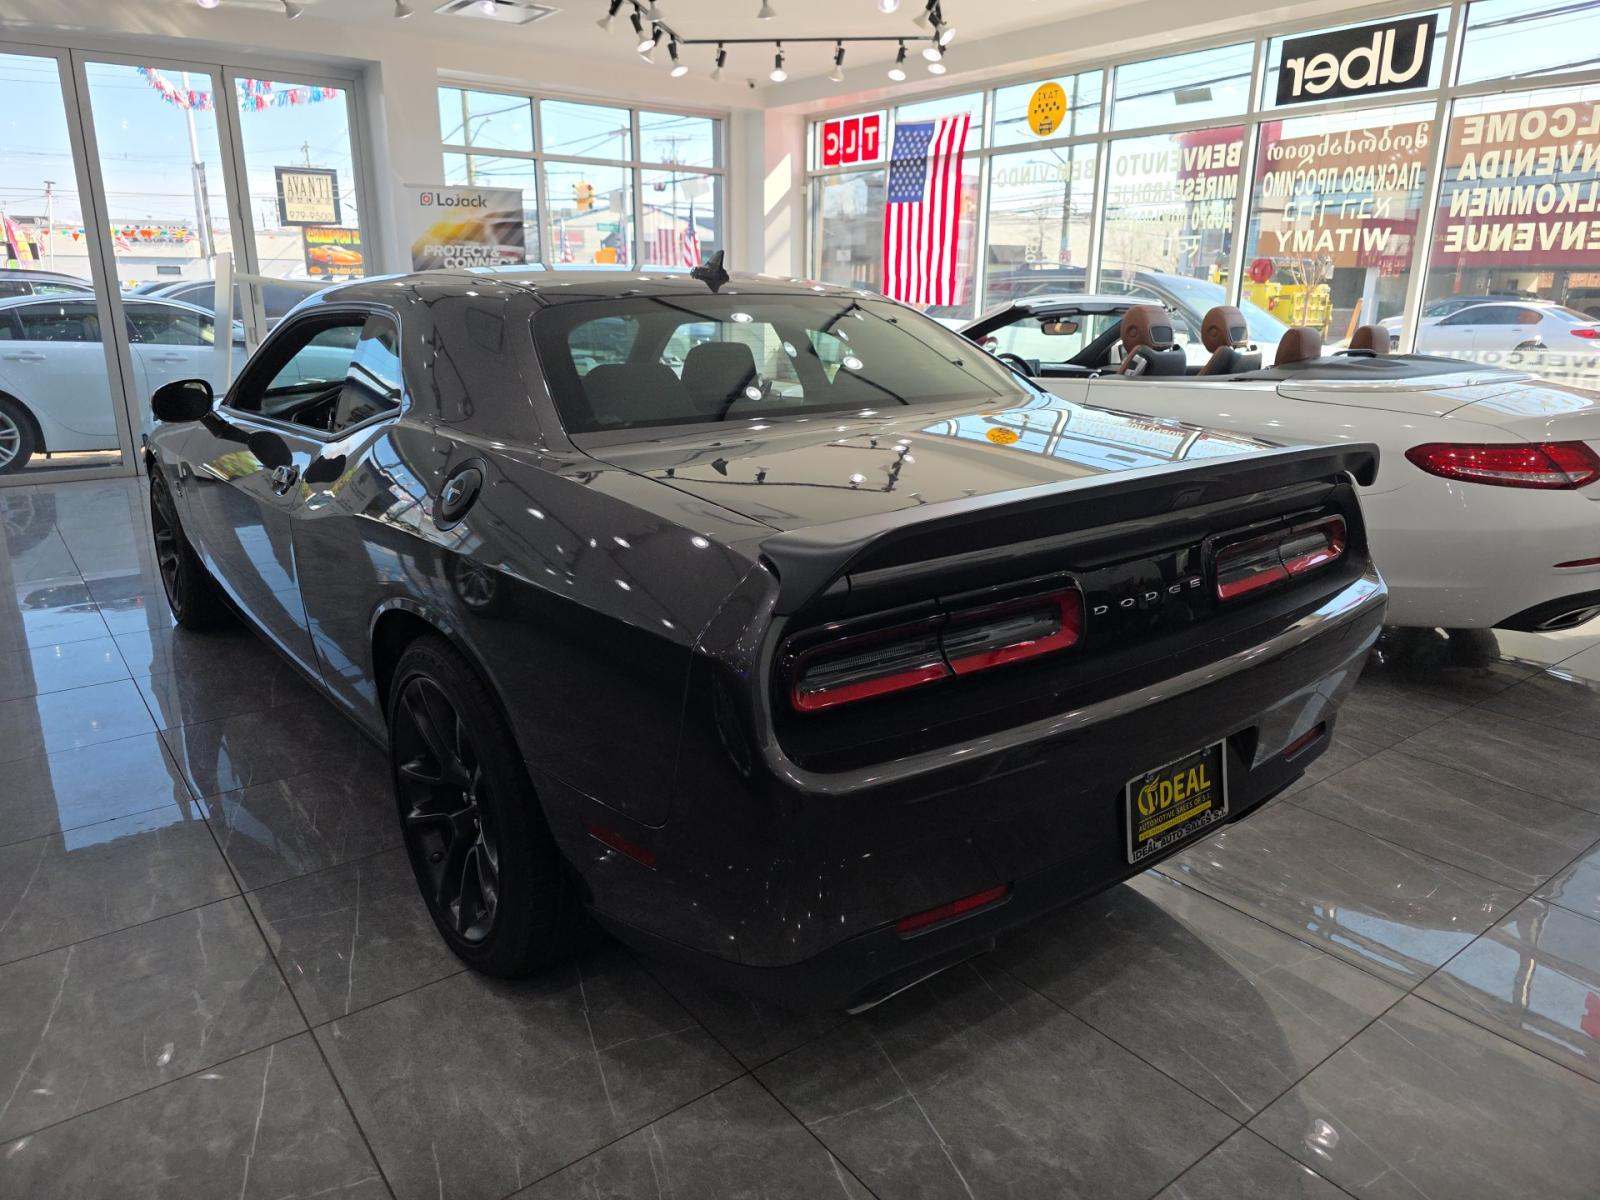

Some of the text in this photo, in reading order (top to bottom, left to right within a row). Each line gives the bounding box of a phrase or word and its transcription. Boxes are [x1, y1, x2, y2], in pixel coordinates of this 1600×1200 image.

[287, 175, 330, 199] AVANTI
[423, 244, 490, 257] PROTECT
[1093, 578, 1201, 615] DODGE
